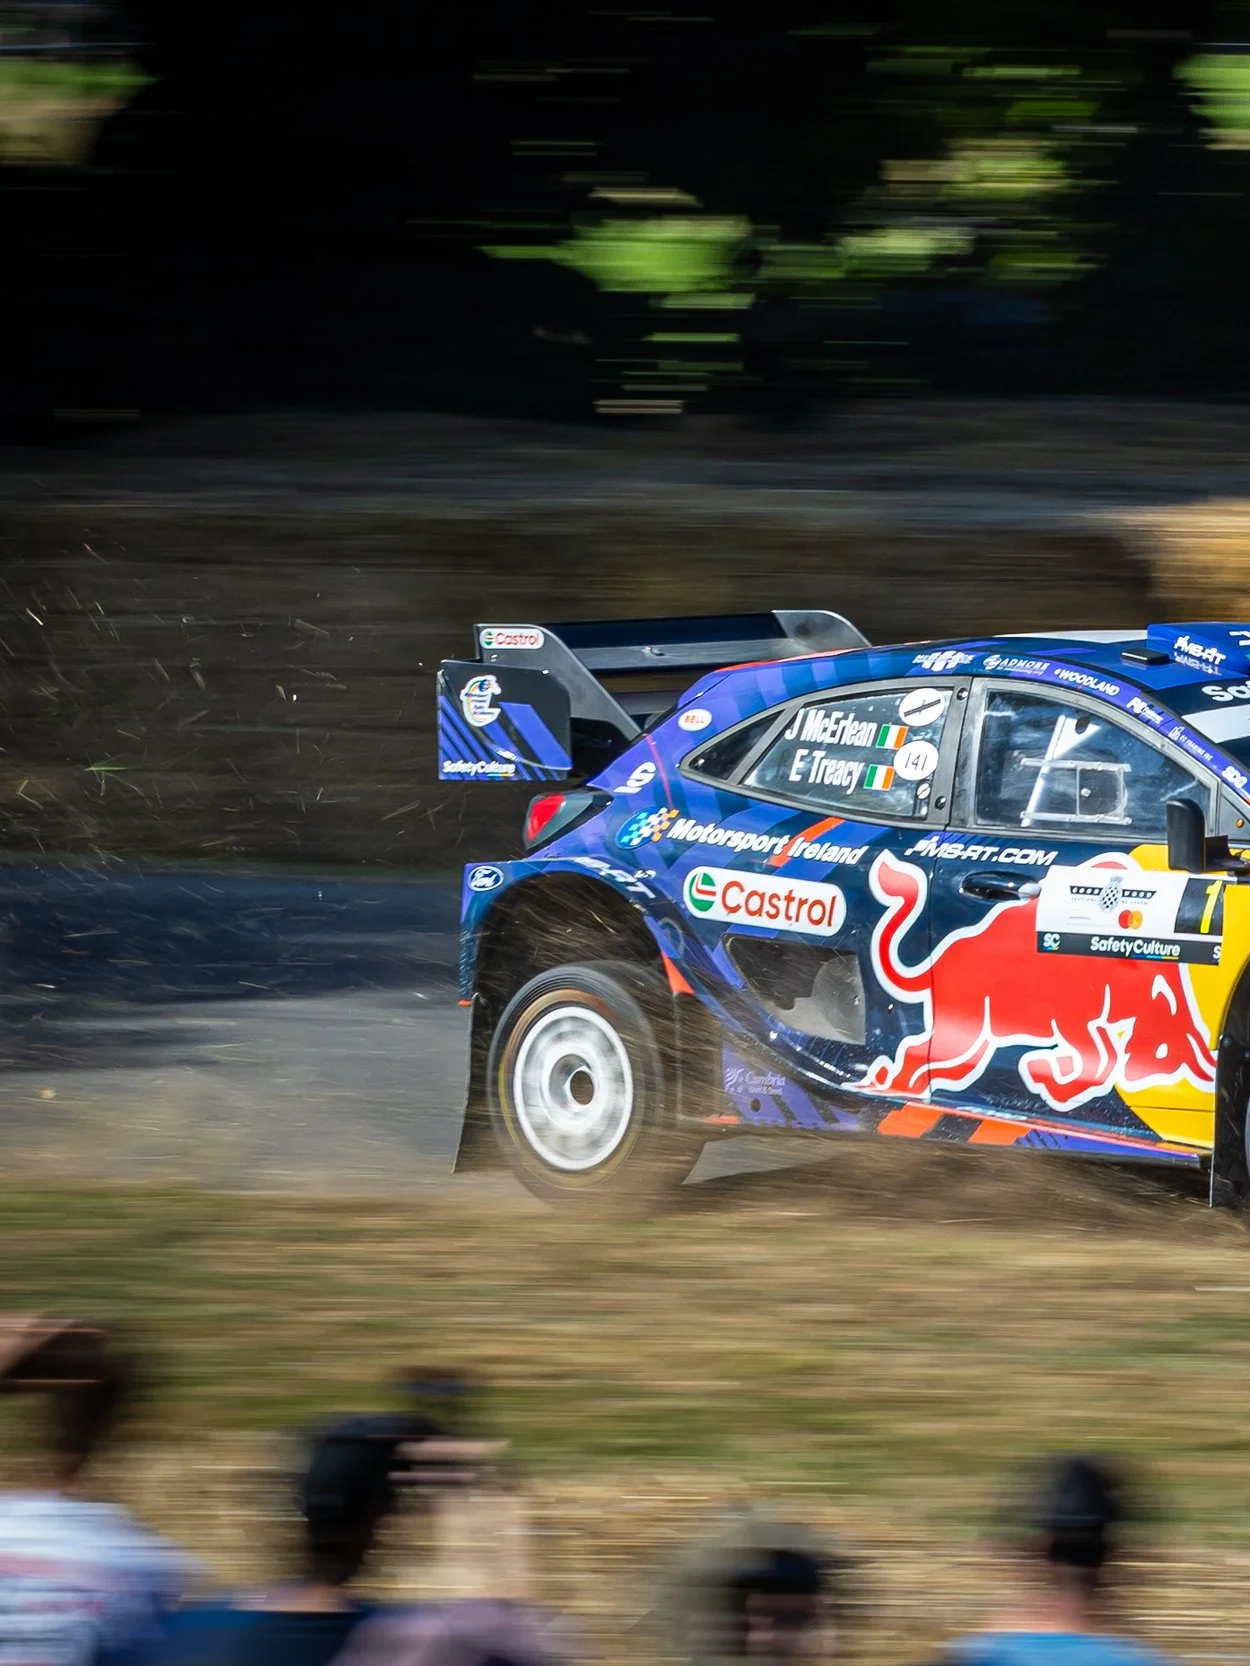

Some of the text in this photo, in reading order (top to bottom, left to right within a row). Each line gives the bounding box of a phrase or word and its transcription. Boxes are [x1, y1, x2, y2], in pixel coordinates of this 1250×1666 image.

[495, 632, 541, 646] Castrol
[1059, 668, 1120, 696] WOODLAND
[785, 708, 877, 747] J McErlean
[442, 760, 516, 776] SafetyCulture
[789, 749, 864, 794] E Treacy
[666, 818, 868, 865] Motorsport Ireland
[722, 881, 837, 927] Castrol
[1043, 933, 1061, 948] SC
[1090, 937, 1181, 956] SafetyCulture
